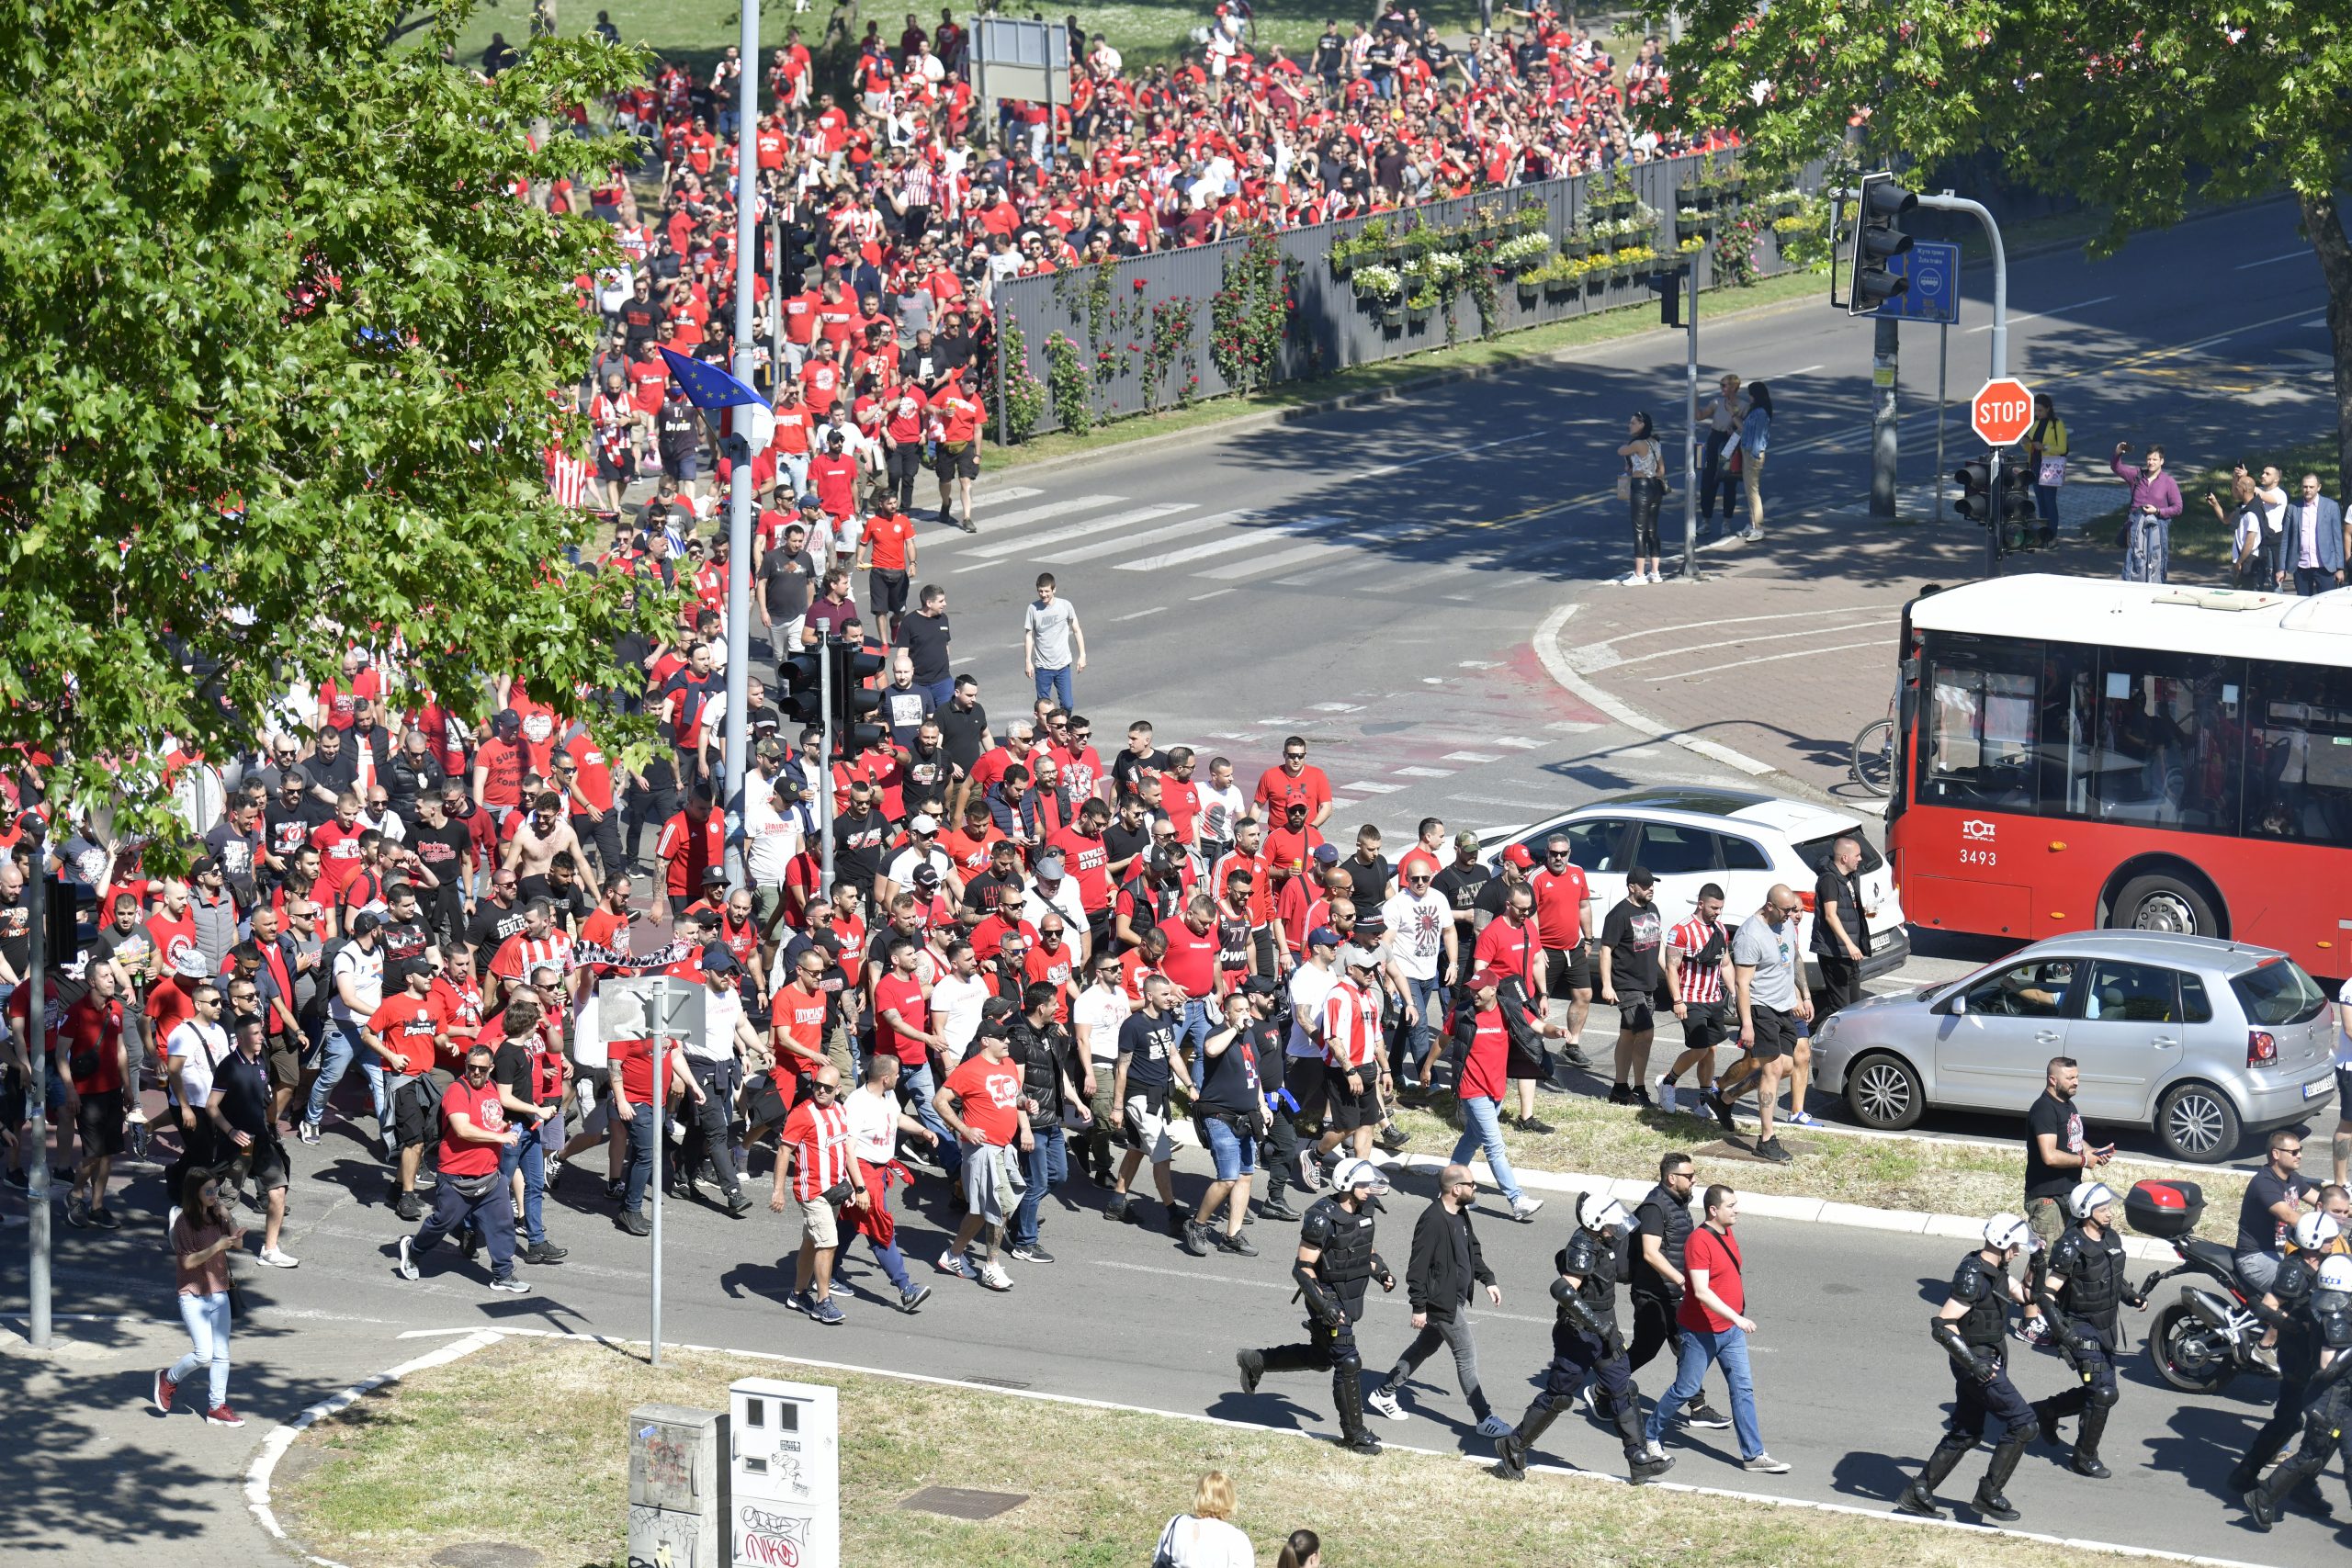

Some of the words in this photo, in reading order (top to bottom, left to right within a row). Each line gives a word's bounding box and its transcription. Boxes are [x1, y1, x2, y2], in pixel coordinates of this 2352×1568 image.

[1980, 400, 2027, 424] STOP
[1041, 615, 1059, 626] NIKE
[1960, 849, 1996, 866] 3493
[1230, 927, 1246, 942] 77
[842, 950, 860, 960] adida
[532, 959, 565, 970] SIEMENS
